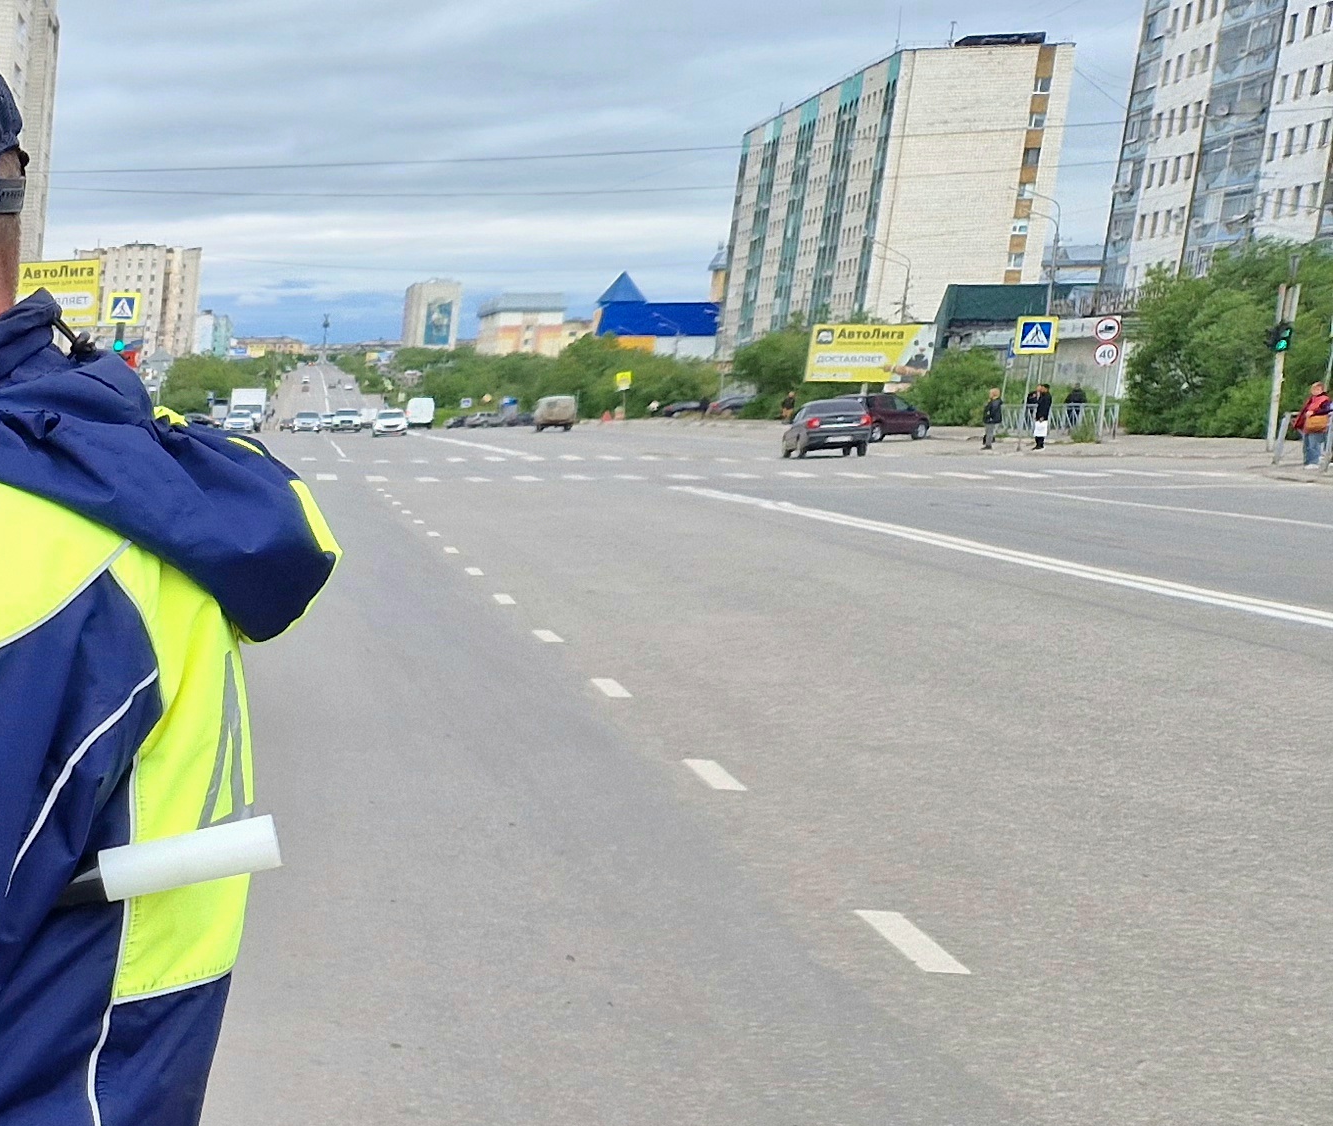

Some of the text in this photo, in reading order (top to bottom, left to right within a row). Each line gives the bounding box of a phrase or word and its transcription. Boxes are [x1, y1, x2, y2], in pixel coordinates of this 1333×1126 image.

[23, 265, 95, 280] АвтоЛига
[837, 328, 905, 340] АвтоЛига
[816, 355, 883, 364] ДОСТАВЛЯЕТ
[1099, 349, 1114, 359] 40
